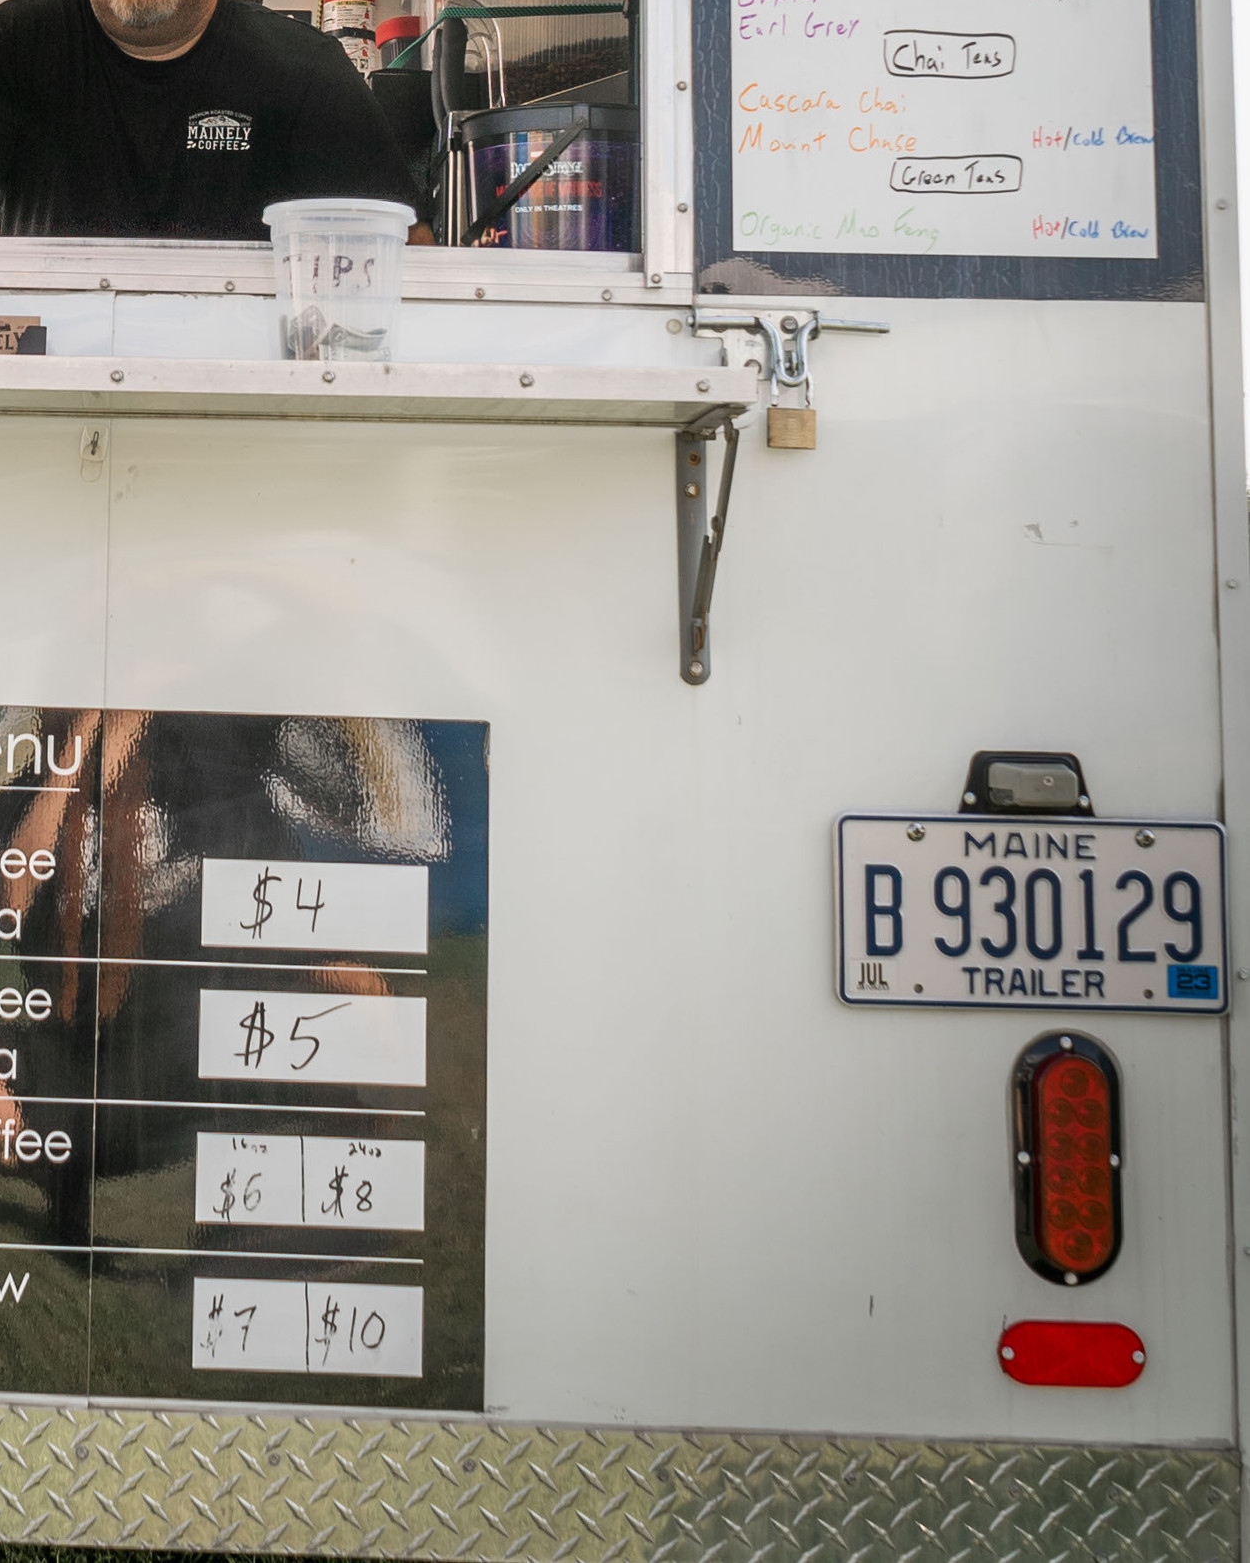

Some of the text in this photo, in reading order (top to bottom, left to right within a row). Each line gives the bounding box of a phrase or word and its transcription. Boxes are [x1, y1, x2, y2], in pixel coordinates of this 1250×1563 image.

[739, 12, 860, 39] Earl Grey
[892, 39, 1002, 73] Chai Teas
[738, 83, 906, 115] Cascara Chai
[187, 126, 251, 140] MAINELY
[198, 140, 239, 150] COFFEE
[738, 123, 827, 154] Mount
[848, 125, 918, 153] Chase
[902, 161, 1006, 190] Green Teas
[515, 205, 533, 213] ONLY
[544, 204, 583, 212] THEATRES
[740, 211, 822, 246] Organic
[283, 254, 375, 298] TIPS
[963, 832, 1096, 860] MAINE
[240, 866, 325, 939] $4
[865, 864, 1203, 963] B 930129
[858, 962, 888, 986] JUL
[962, 966, 1105, 998] TRAILER
[1177, 973, 1211, 990] 23
[234, 1001, 352, 1070] $5
[321, 1165, 373, 1218] $8
